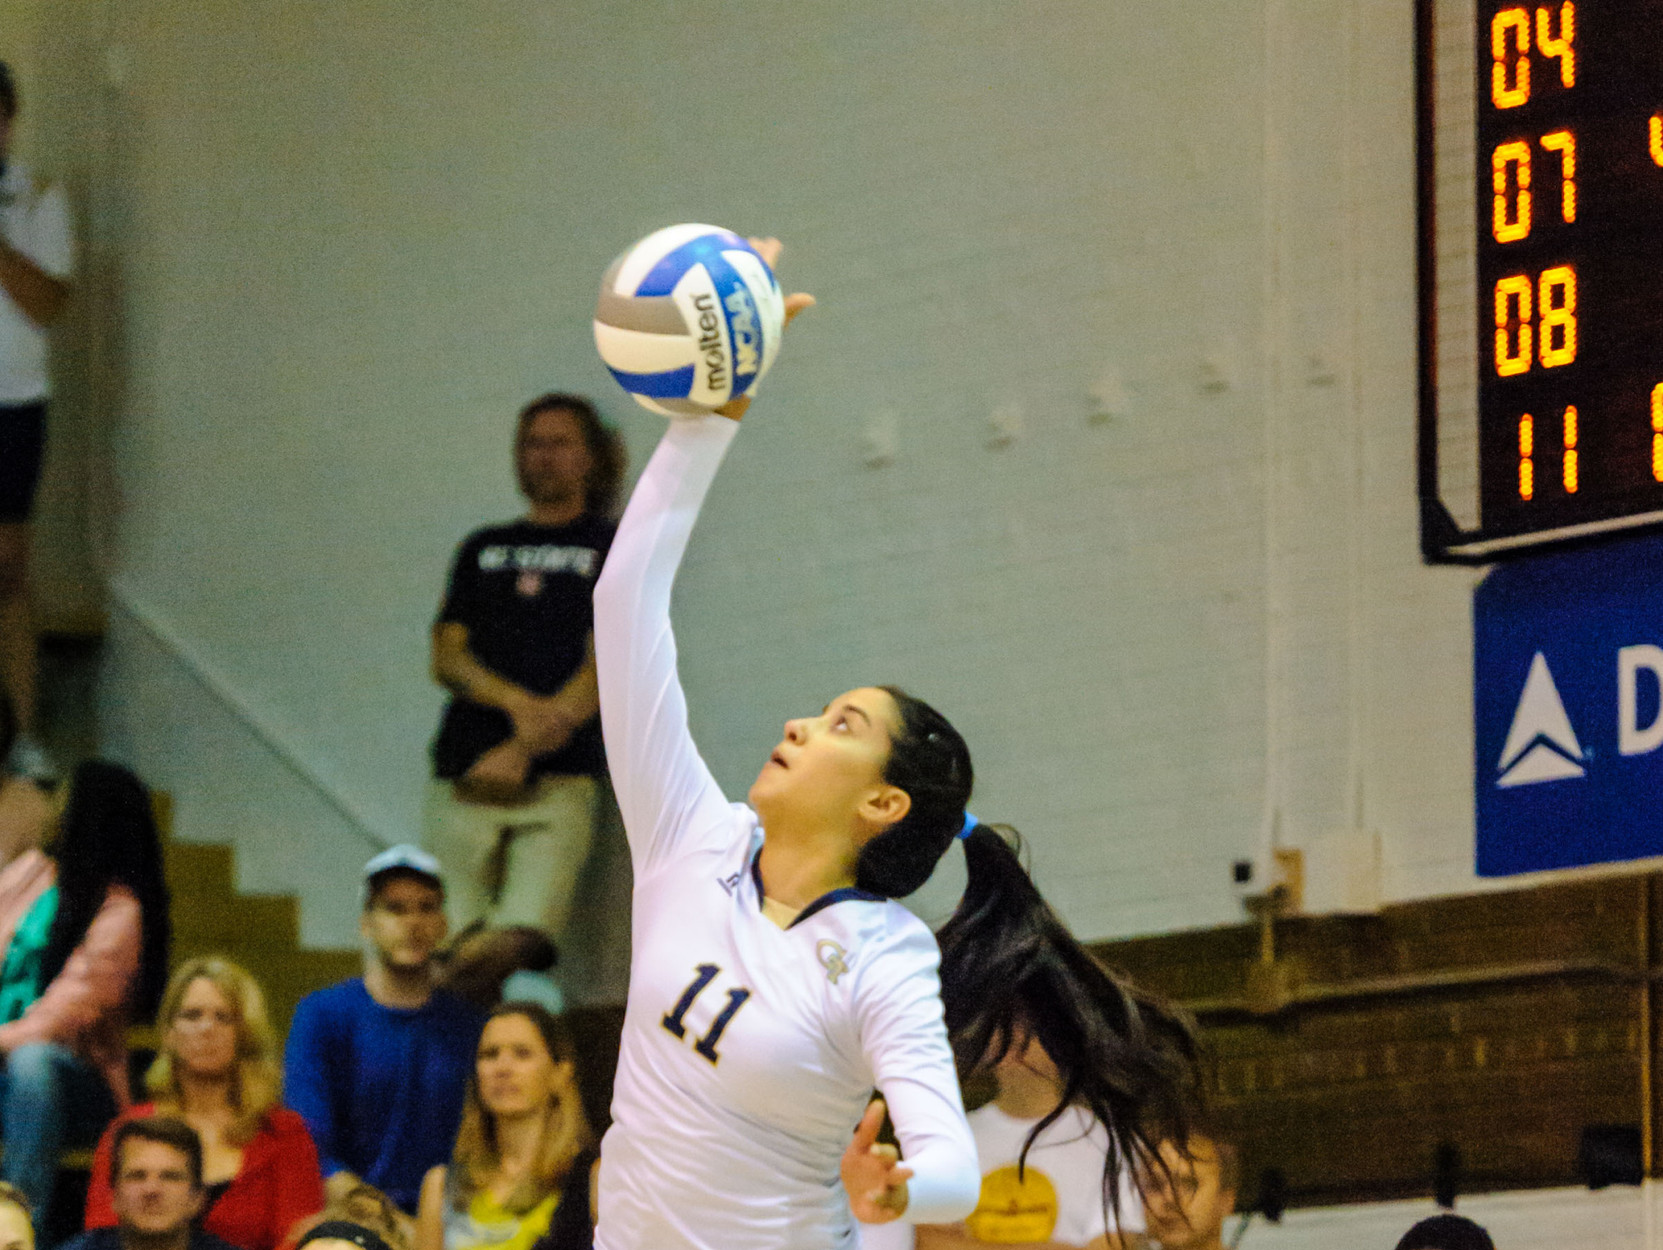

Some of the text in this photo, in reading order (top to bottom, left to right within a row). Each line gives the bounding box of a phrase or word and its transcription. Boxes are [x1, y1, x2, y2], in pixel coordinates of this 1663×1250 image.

[1492, 1, 1576, 109] 04
[1492, 130, 1576, 243] 07
[690, 293, 726, 391] molten
[1494, 265, 1577, 377] 08
[1518, 405, 1579, 500] 11
[660, 961, 752, 1067] 11
